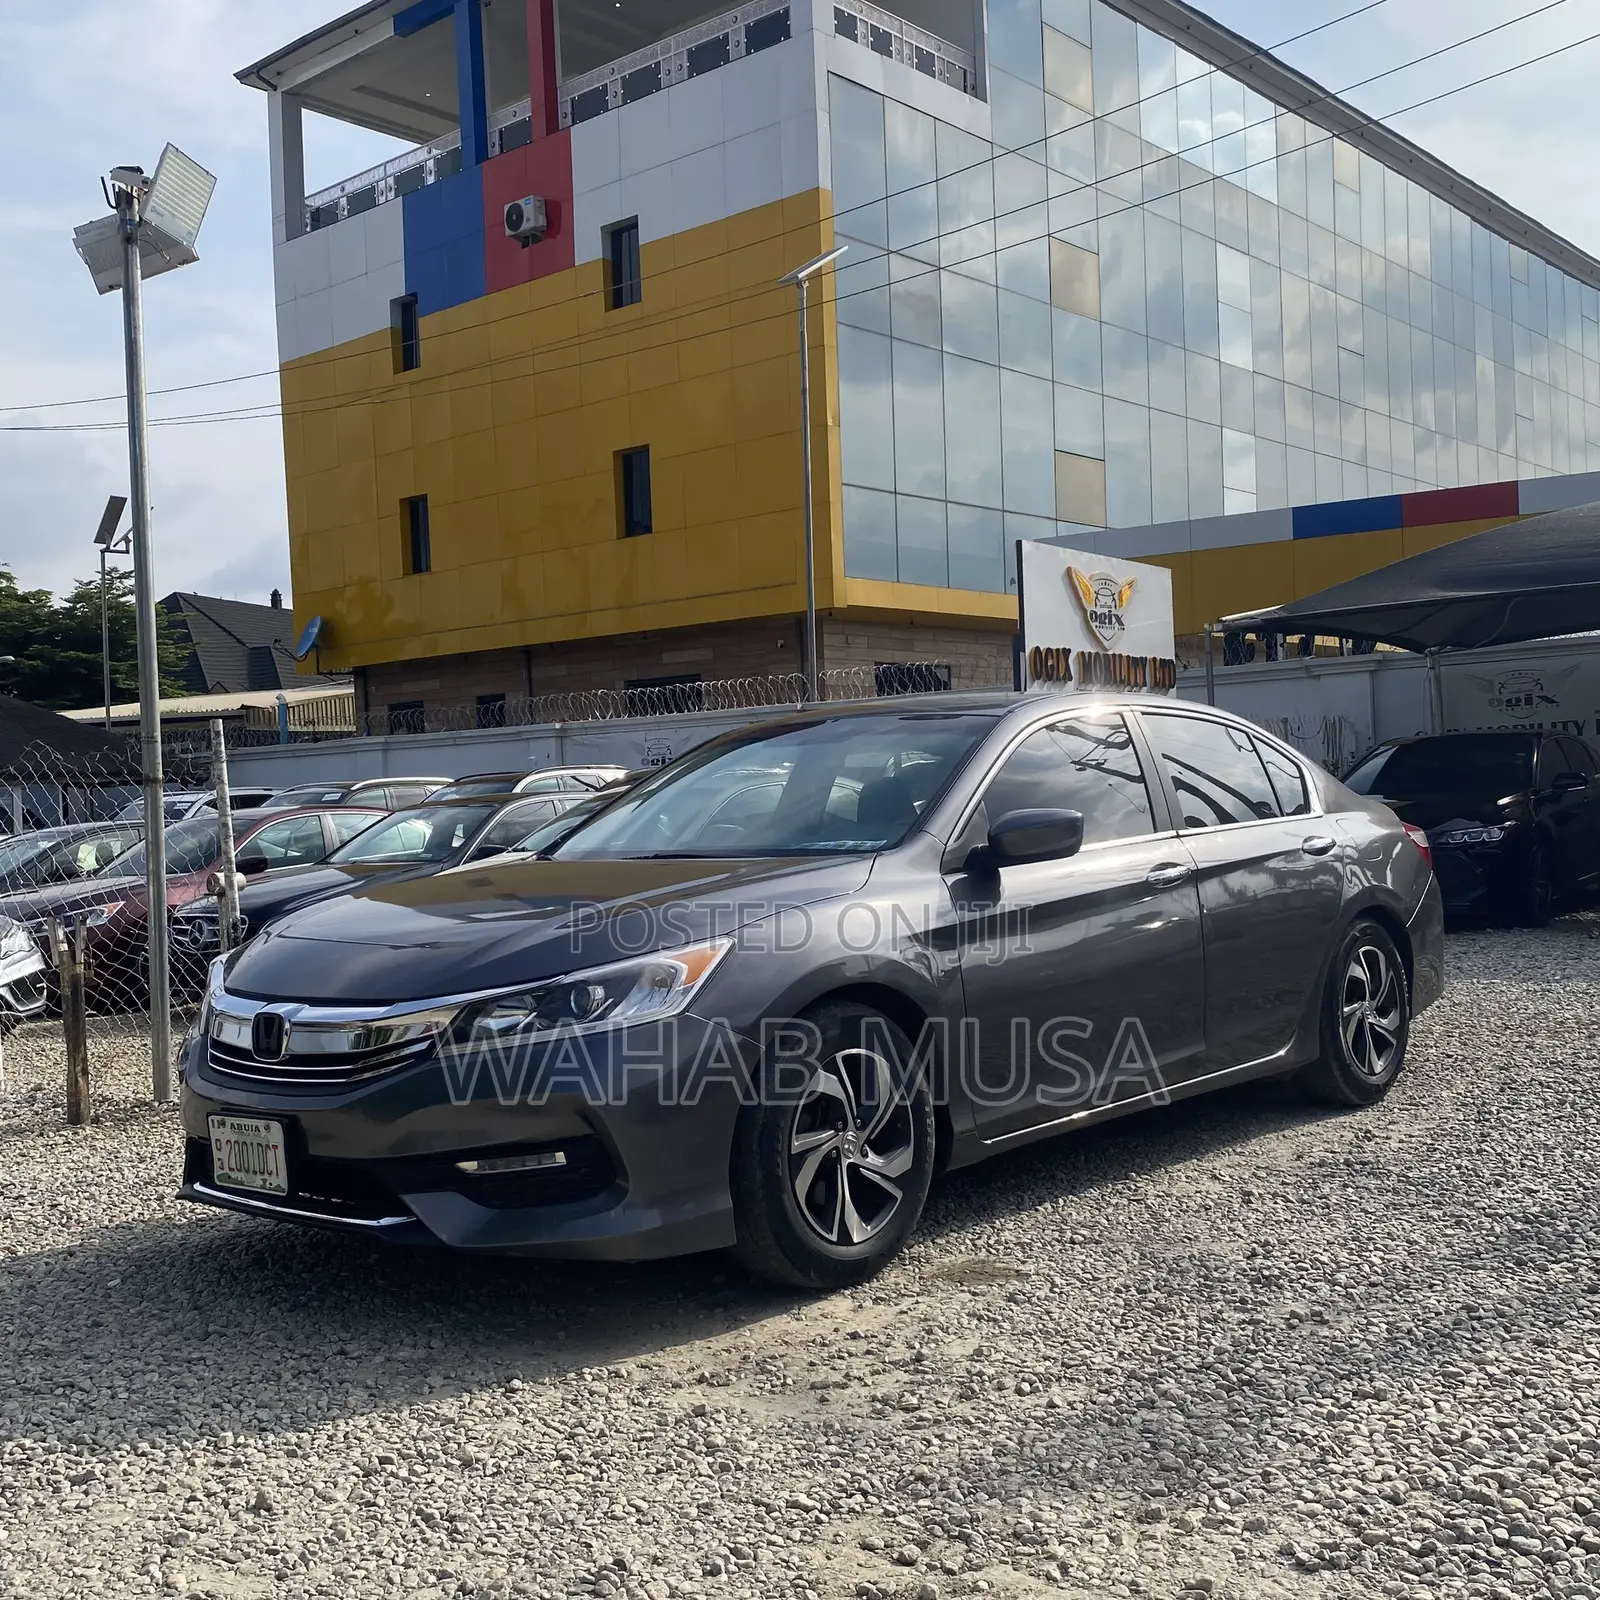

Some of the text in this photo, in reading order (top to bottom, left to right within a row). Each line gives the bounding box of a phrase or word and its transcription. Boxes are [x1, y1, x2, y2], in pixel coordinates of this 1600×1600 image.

[1029, 645, 1176, 689] OGIX MOBILITY LTD
